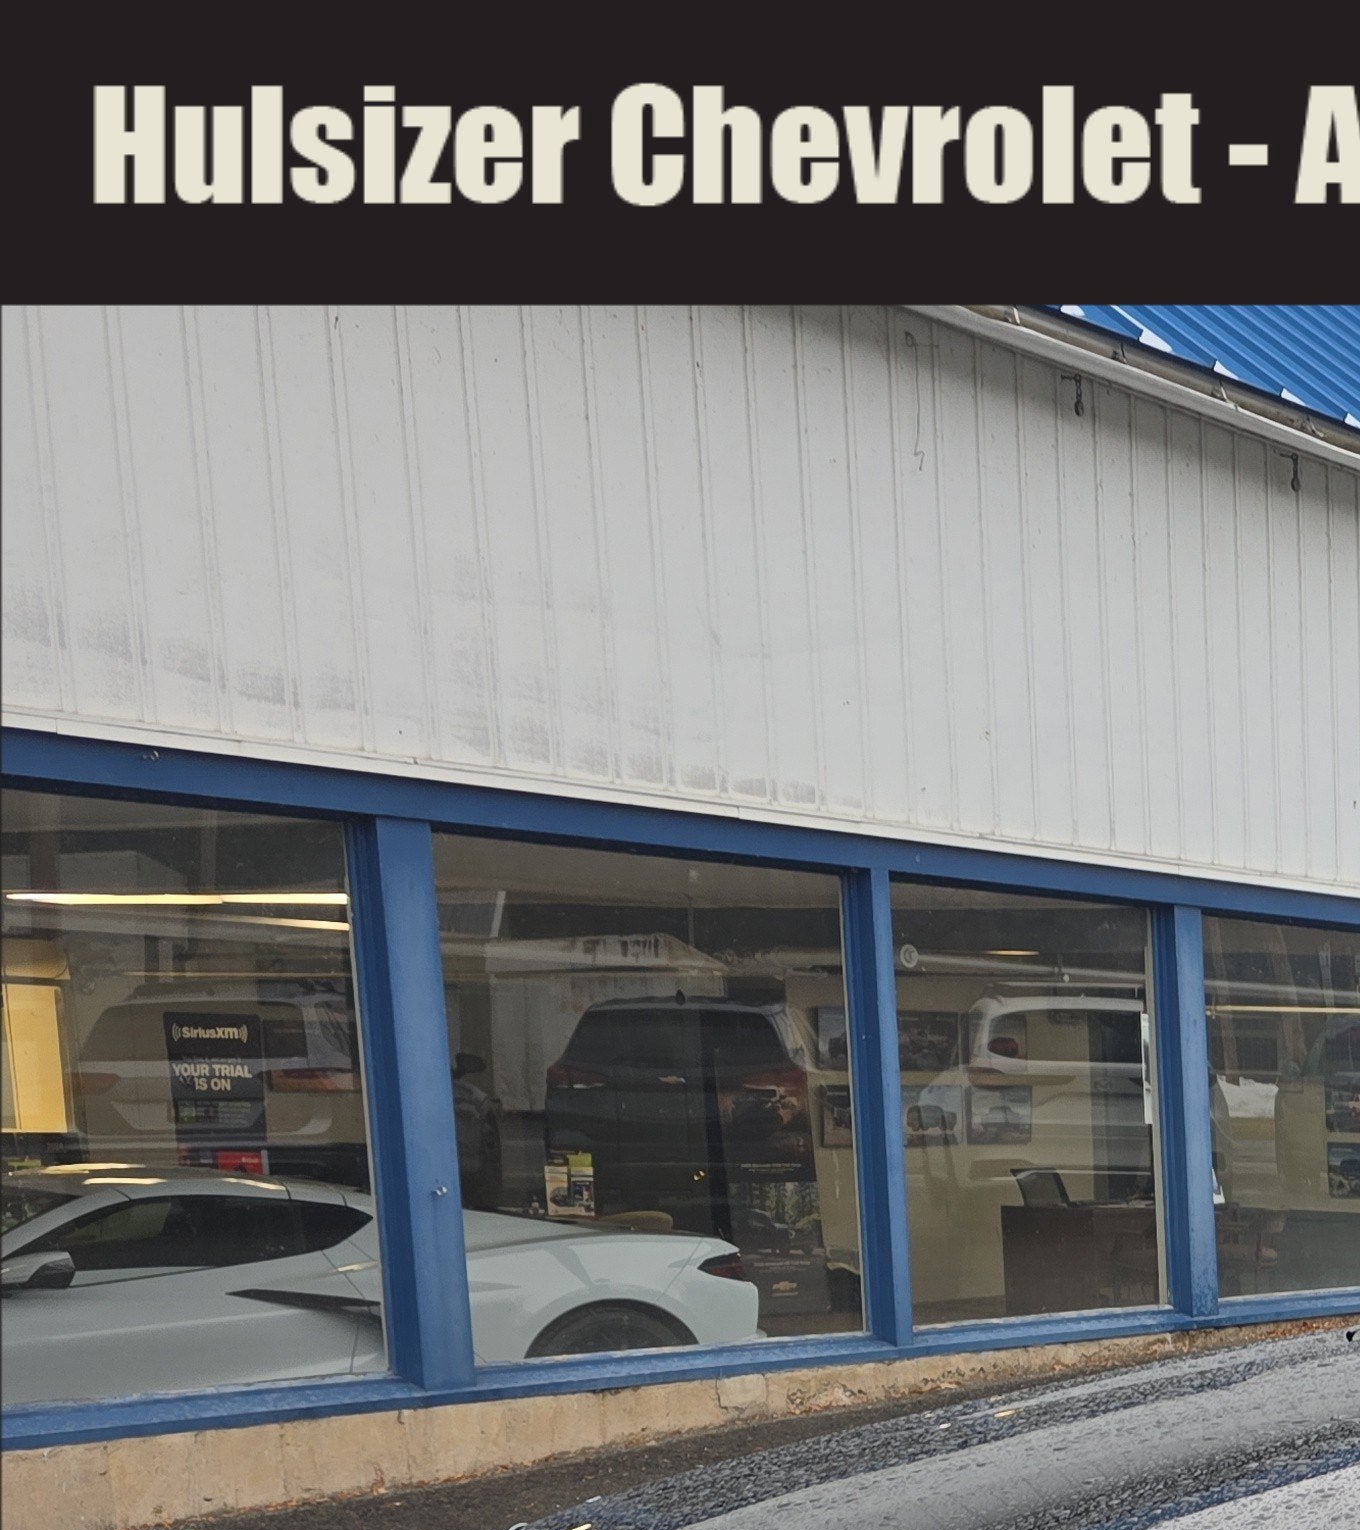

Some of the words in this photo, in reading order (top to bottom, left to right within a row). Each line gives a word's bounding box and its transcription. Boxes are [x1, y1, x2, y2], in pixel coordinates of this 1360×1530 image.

[172, 1063, 209, 1077] YOUR
[211, 1063, 253, 1078] TRIAL
[195, 1079, 208, 1091] IS
[211, 1079, 232, 1091] ON
